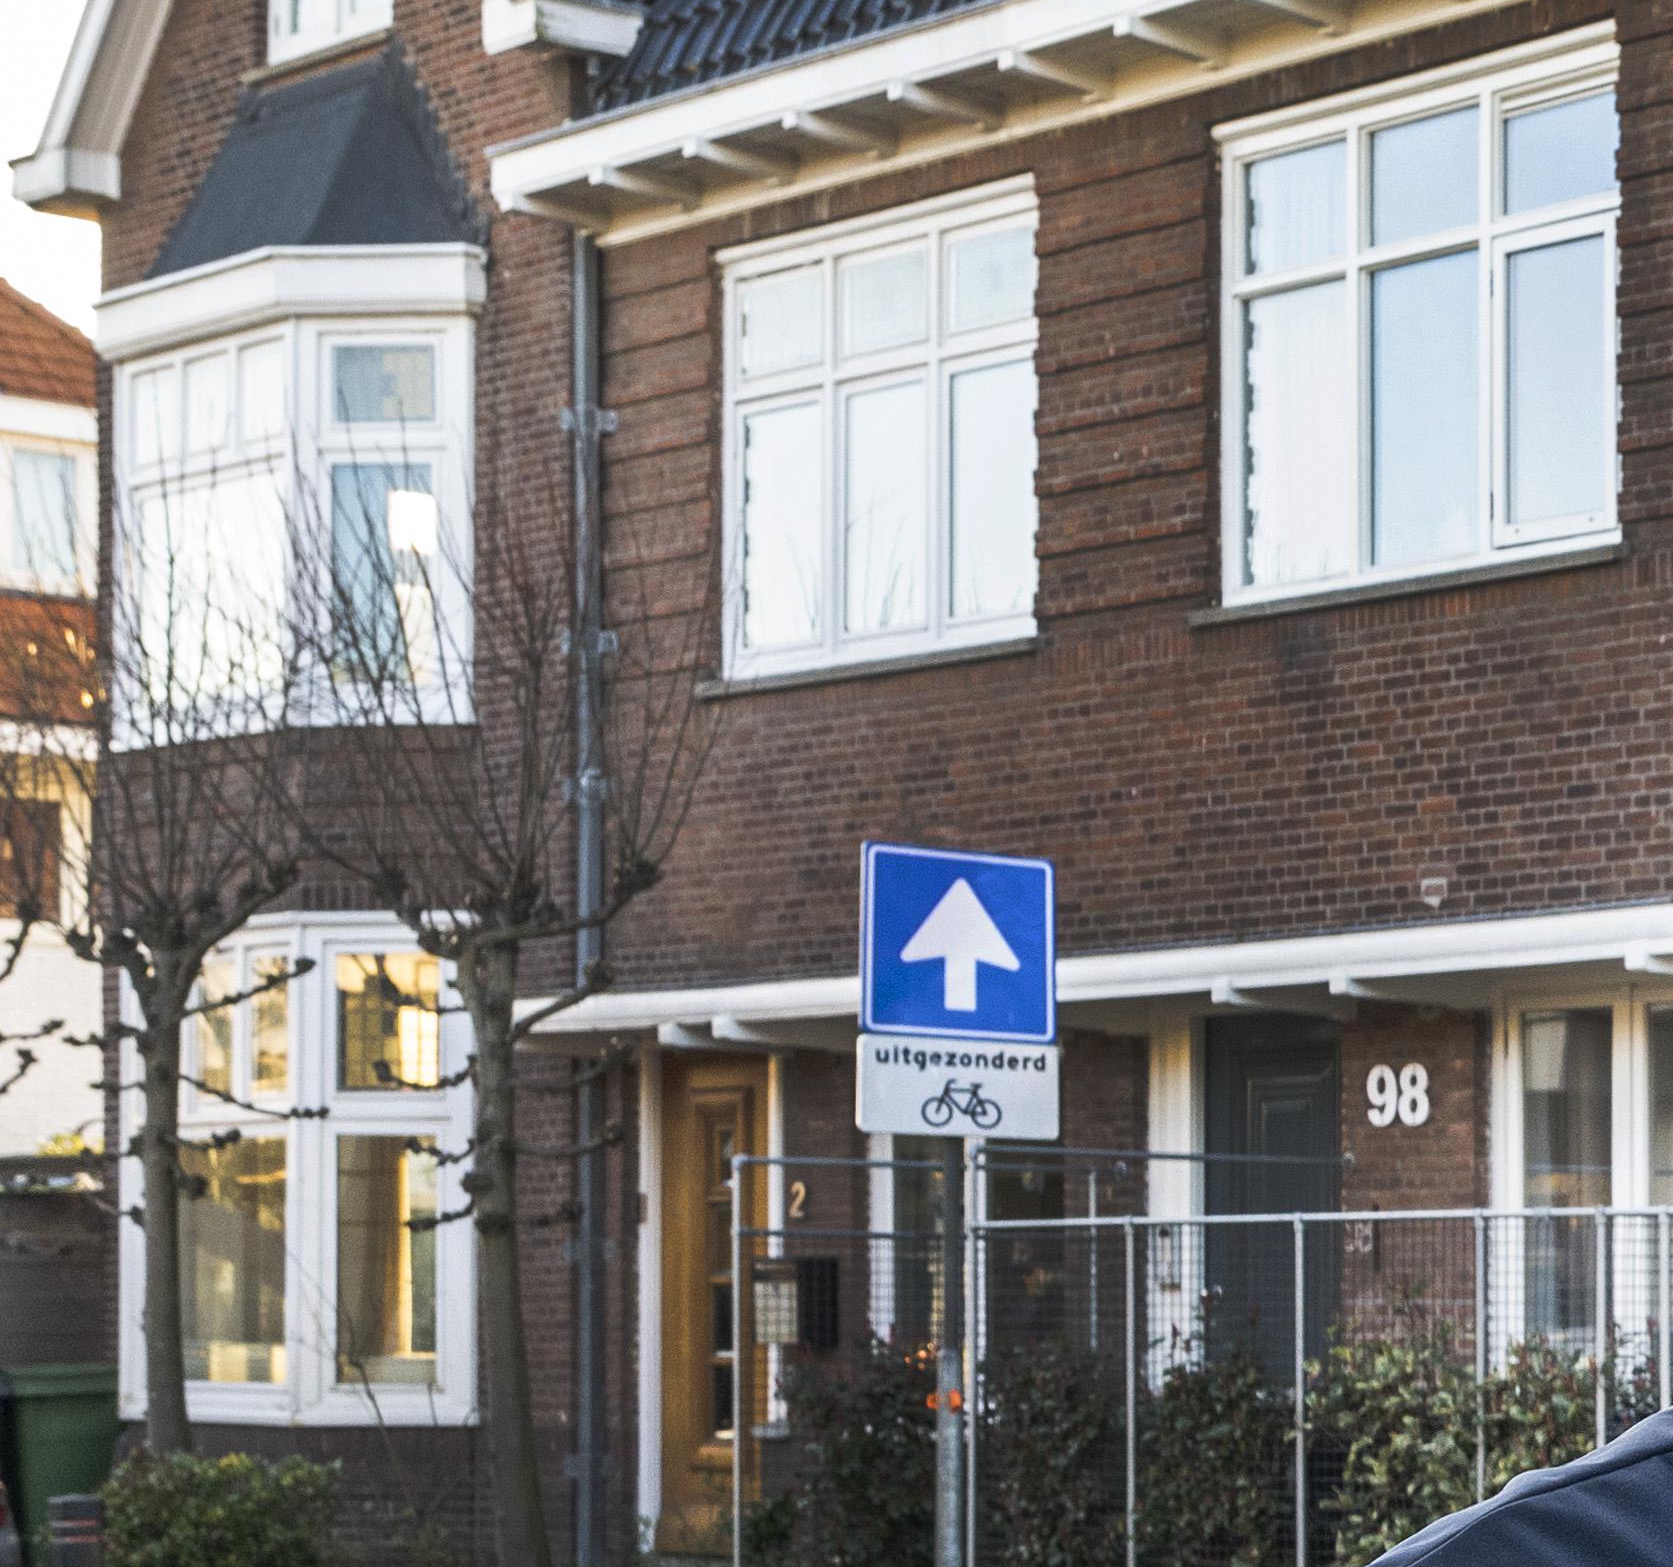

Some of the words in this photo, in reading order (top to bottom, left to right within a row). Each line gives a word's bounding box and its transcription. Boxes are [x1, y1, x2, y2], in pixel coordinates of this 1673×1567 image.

[875, 1044, 1046, 1072] uitgezonderd
[1366, 1062, 1430, 1127] 98
[789, 1181, 805, 1218] 2
